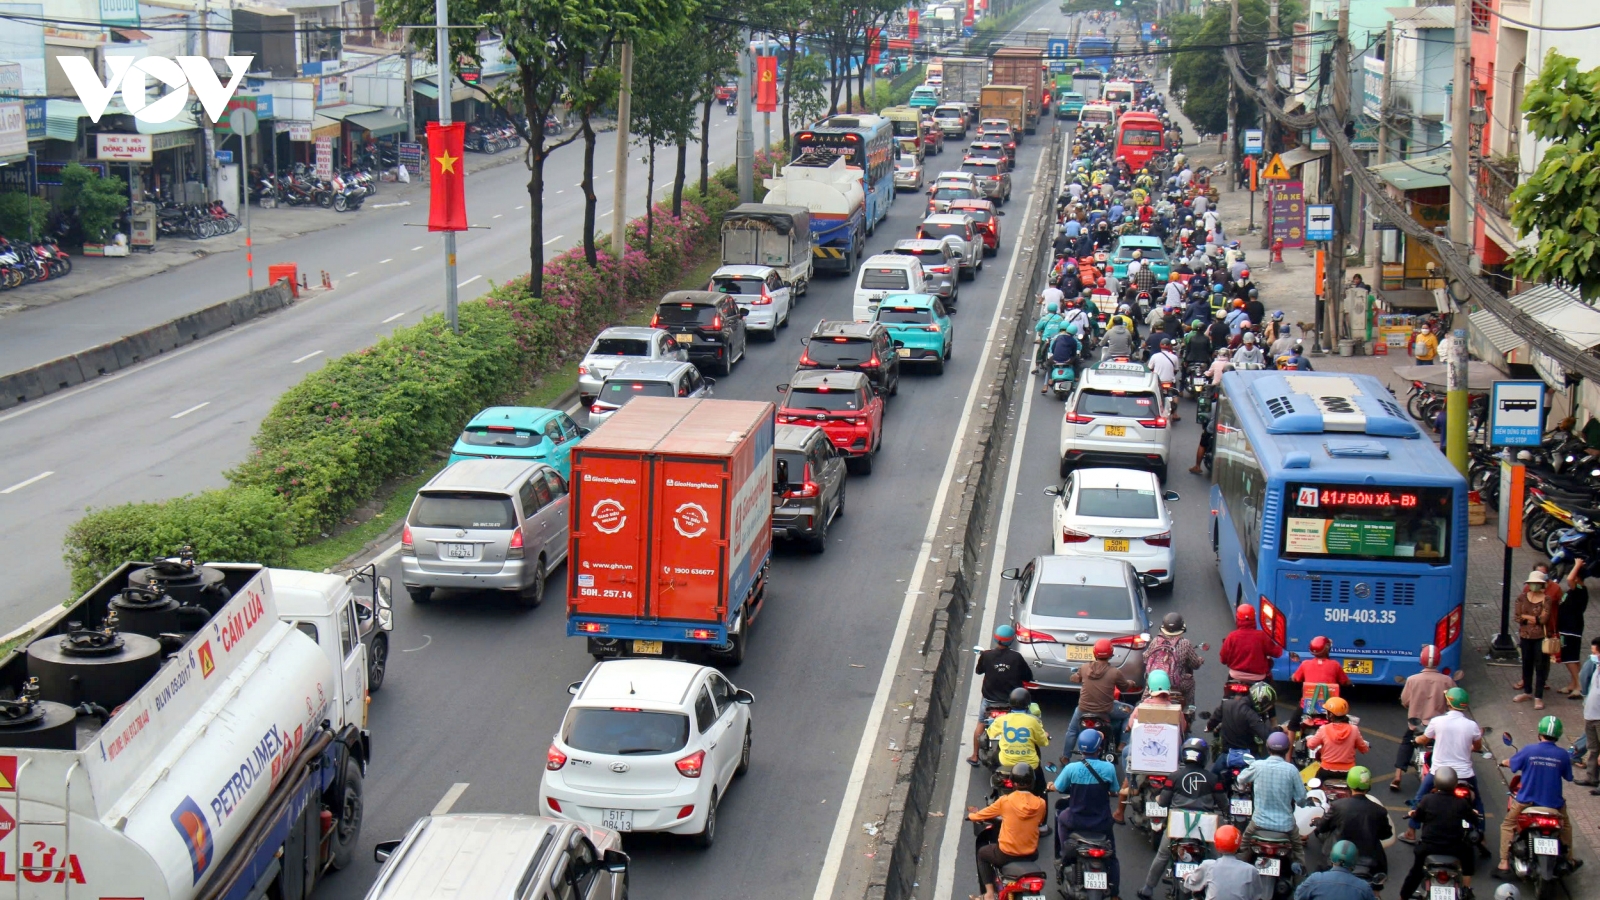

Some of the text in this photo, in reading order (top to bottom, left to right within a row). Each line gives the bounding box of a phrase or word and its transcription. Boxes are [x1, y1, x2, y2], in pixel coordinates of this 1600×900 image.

[1276, 191, 1288, 201] ỬA
[591, 475, 637, 485] GiaoHangNhanh
[674, 480, 719, 489] GiaoHangNhanh
[1300, 490, 1316, 506] 41
[592, 562, 633, 570] www.ghn.vn
[603, 589, 632, 599] 257.14
[1324, 608, 1396, 624] 50H-403.35
[221, 590, 264, 653] CẤM LỬA
[1069, 652, 1093, 660] 520.85
[1003, 721, 1031, 743] be
[210, 723, 283, 828] PETROLIMEX
[609, 810, 625, 820] 51F
[0, 841, 87, 884] LỬA
